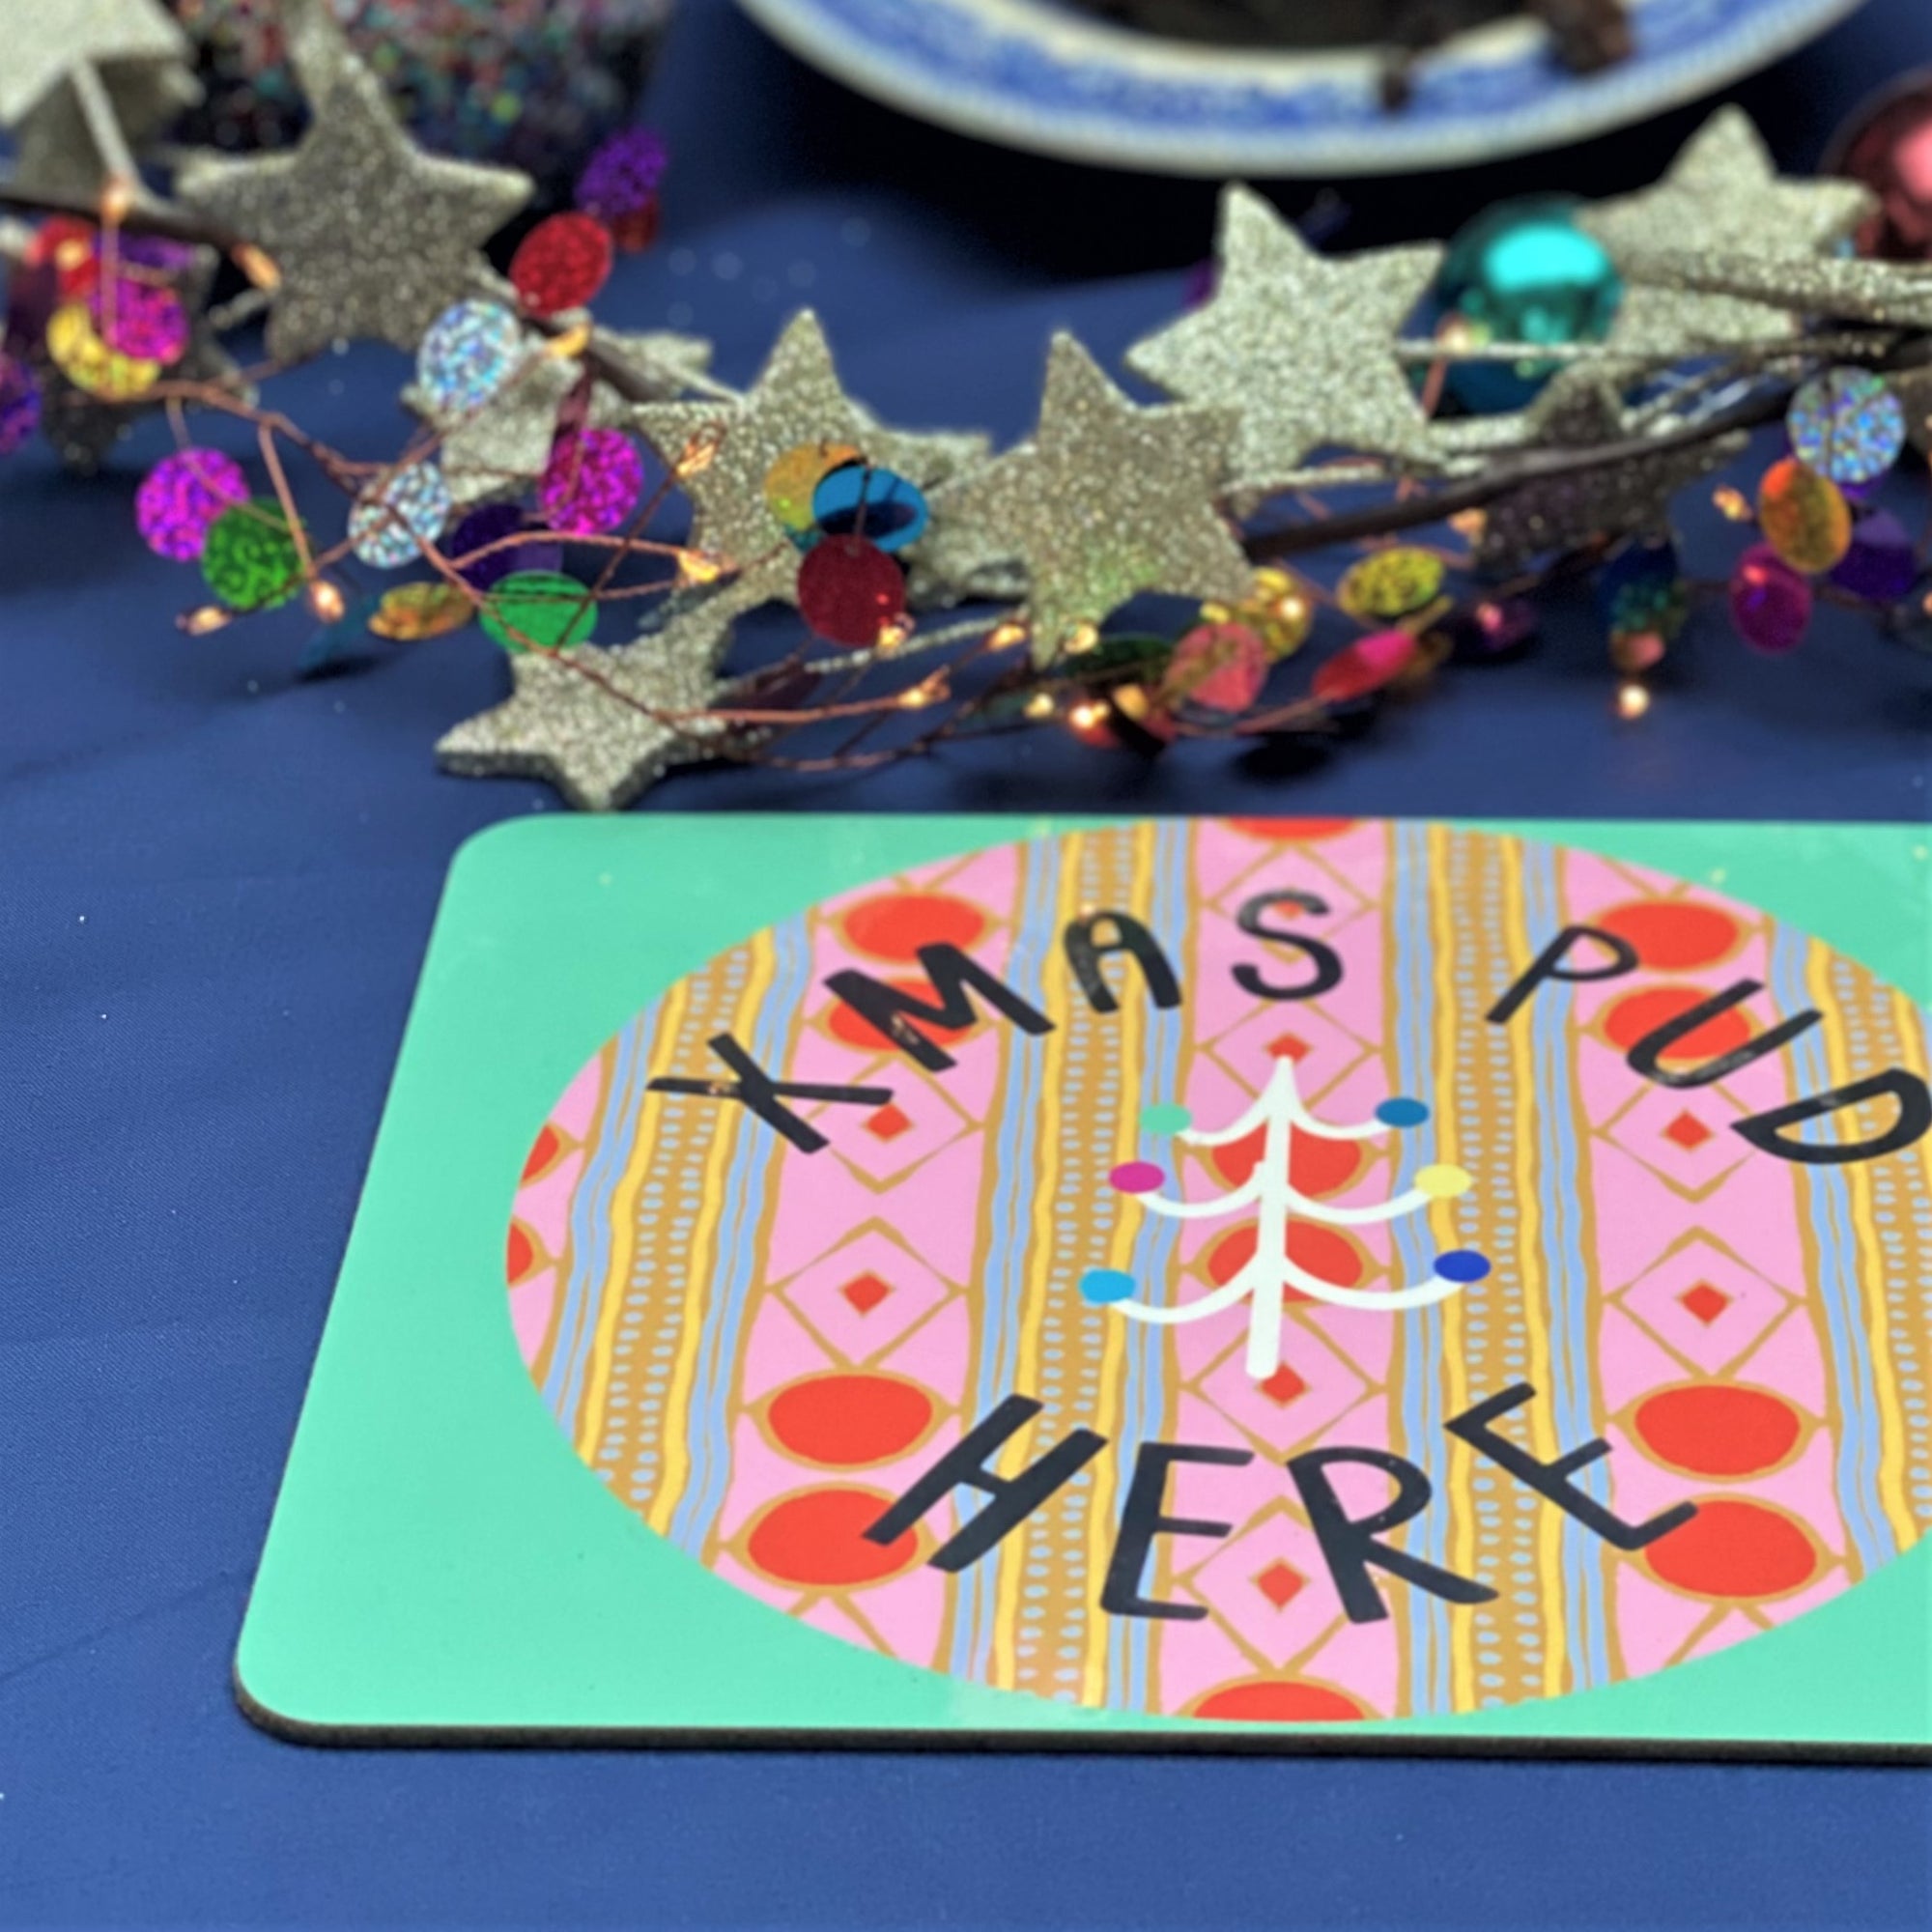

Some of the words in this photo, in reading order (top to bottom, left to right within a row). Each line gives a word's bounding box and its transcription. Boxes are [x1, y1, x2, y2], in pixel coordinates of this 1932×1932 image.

[645, 889, 1343, 1153] XMAS
[1486, 924, 1932, 1164] PUD
[861, 1381, 1697, 1624] HERE
